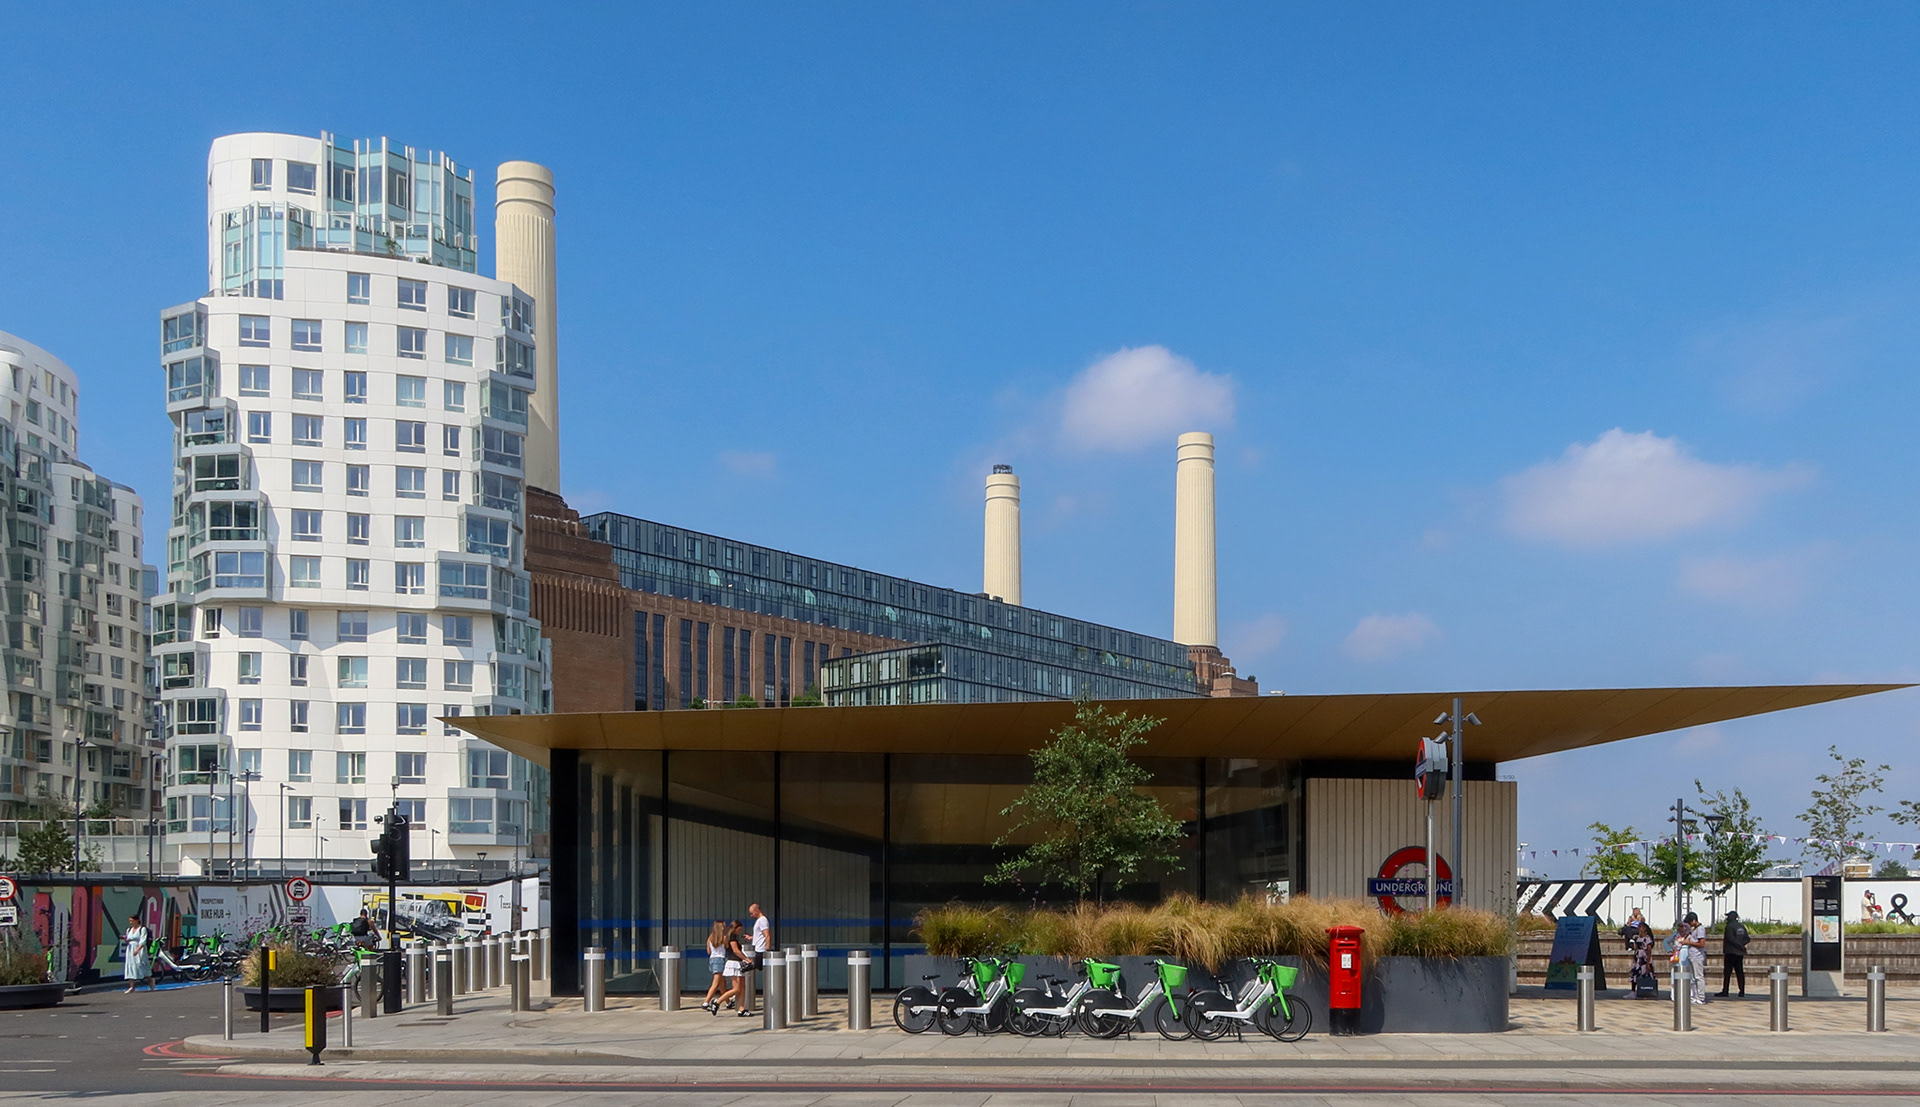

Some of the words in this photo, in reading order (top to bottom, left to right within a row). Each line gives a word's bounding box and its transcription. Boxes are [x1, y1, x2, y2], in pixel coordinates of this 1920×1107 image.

[1376, 883, 1452, 892] UNDERGRN
[201, 909, 213, 919] BIKE
[213, 909, 225, 919] HUB
